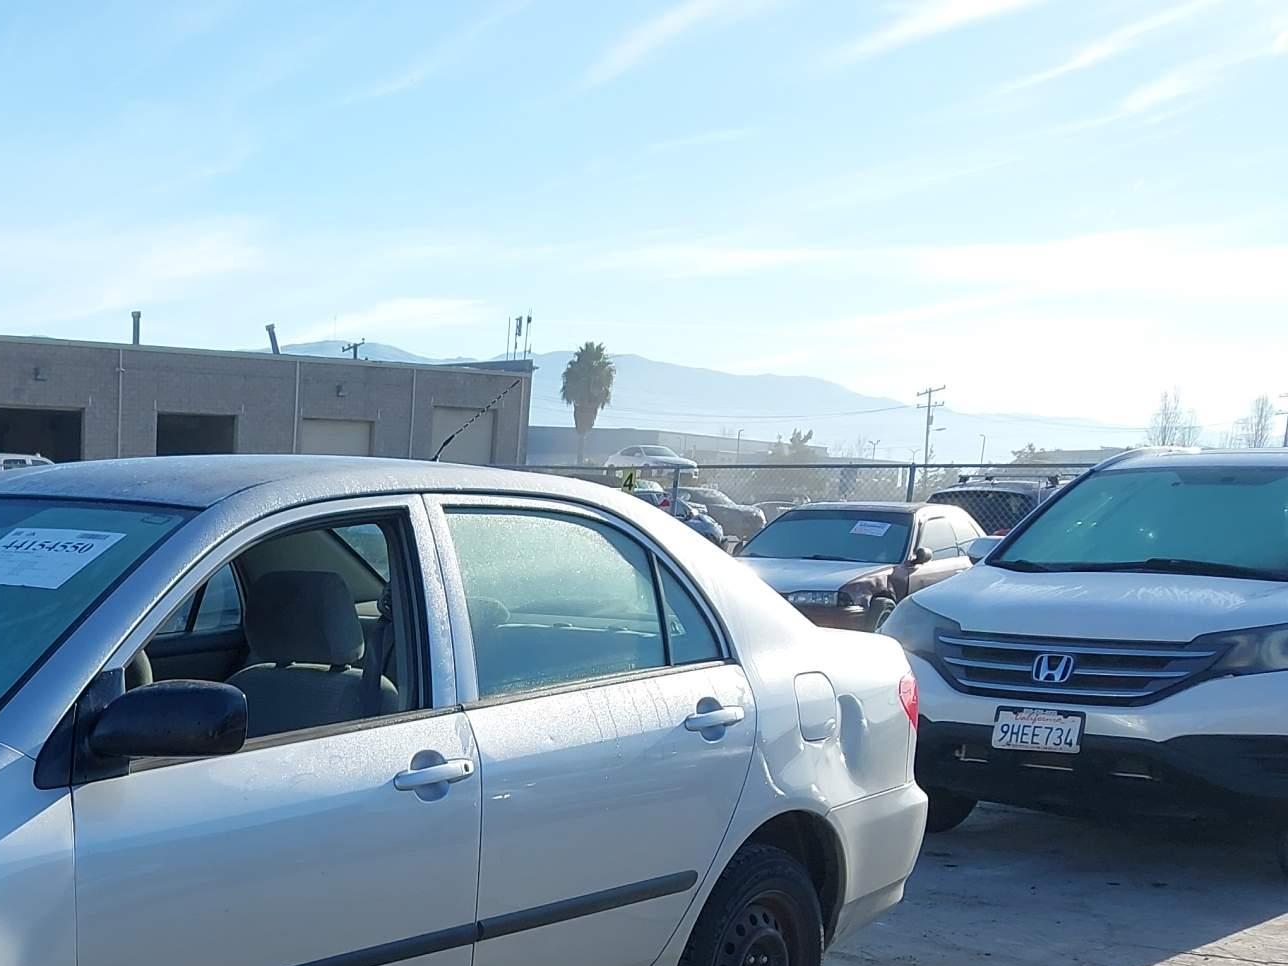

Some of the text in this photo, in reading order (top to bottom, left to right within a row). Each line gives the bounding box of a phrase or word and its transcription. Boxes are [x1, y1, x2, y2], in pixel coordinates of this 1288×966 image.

[623, 472, 633, 491] 4
[2, 539, 95, 554] 44154550
[998, 723, 1073, 747] 9HEE734
